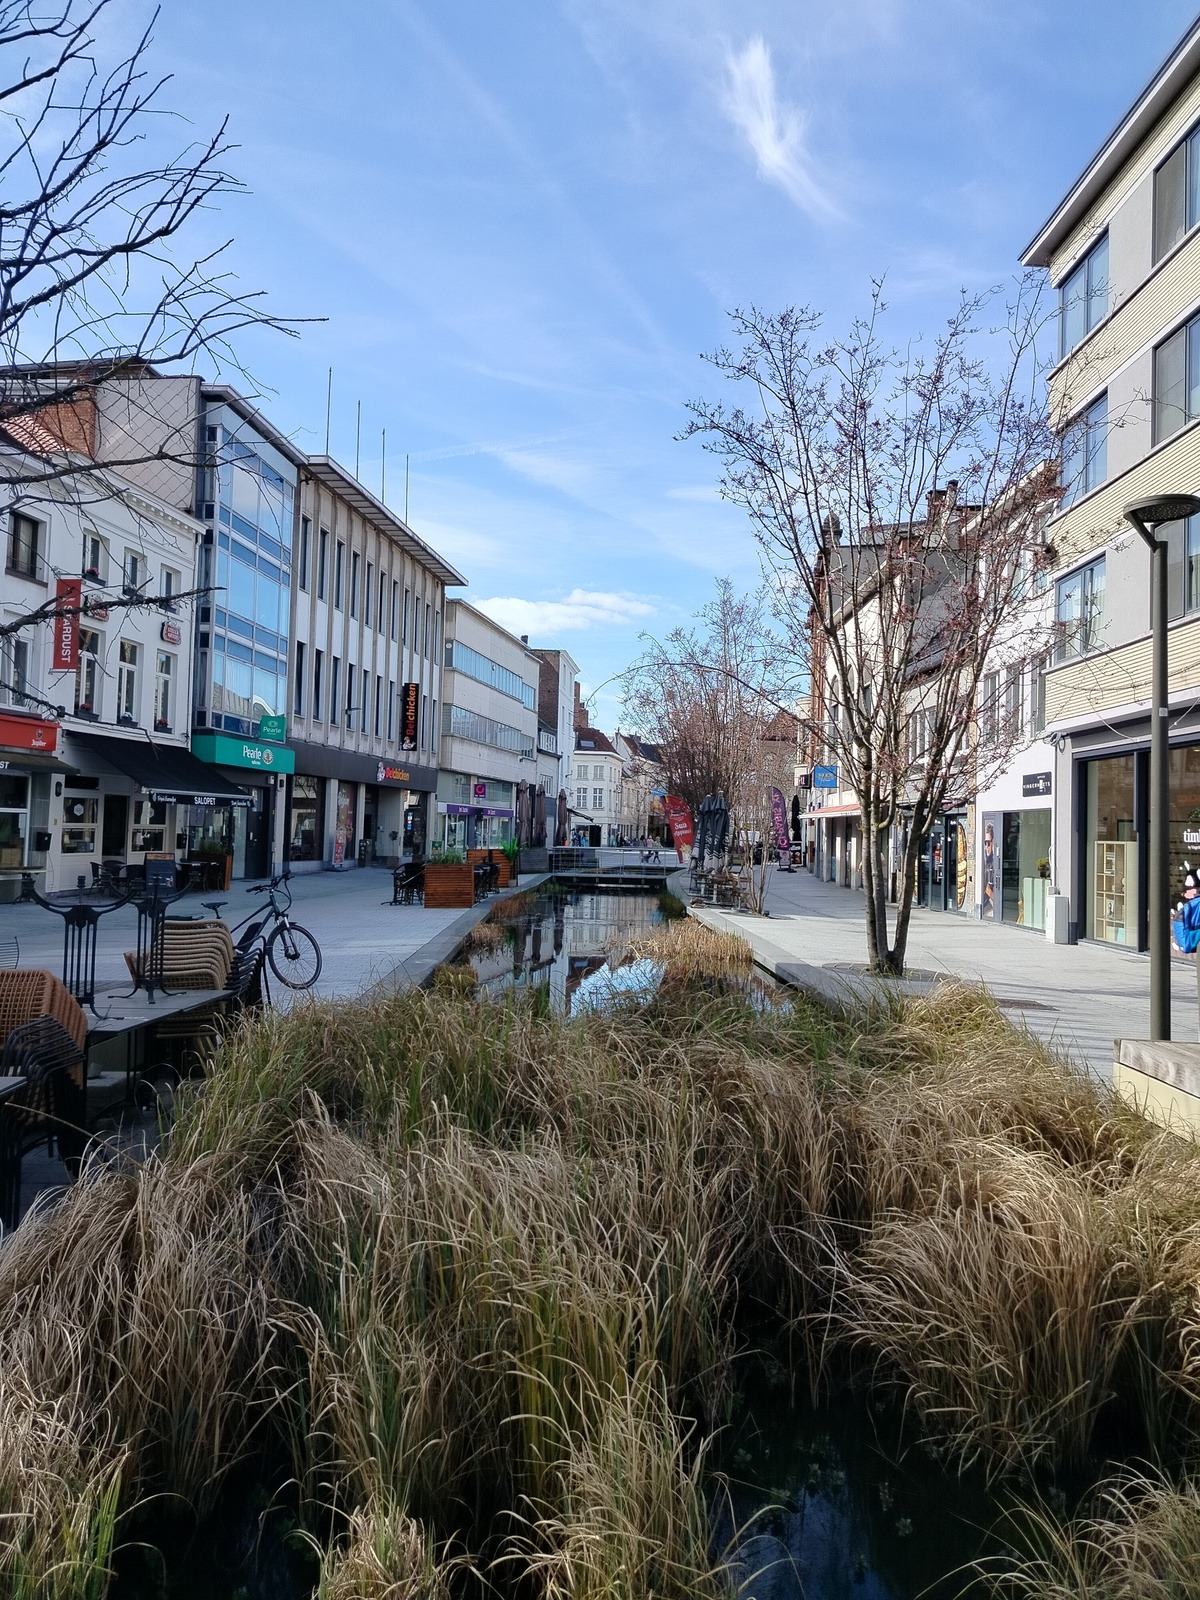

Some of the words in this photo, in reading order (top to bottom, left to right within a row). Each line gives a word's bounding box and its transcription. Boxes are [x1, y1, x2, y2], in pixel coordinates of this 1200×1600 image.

[406, 683, 416, 735] Belchicken
[243, 745, 261, 760] Pearle
[385, 767, 410, 781] Belchicken
[194, 796, 216, 805] SALOPET
